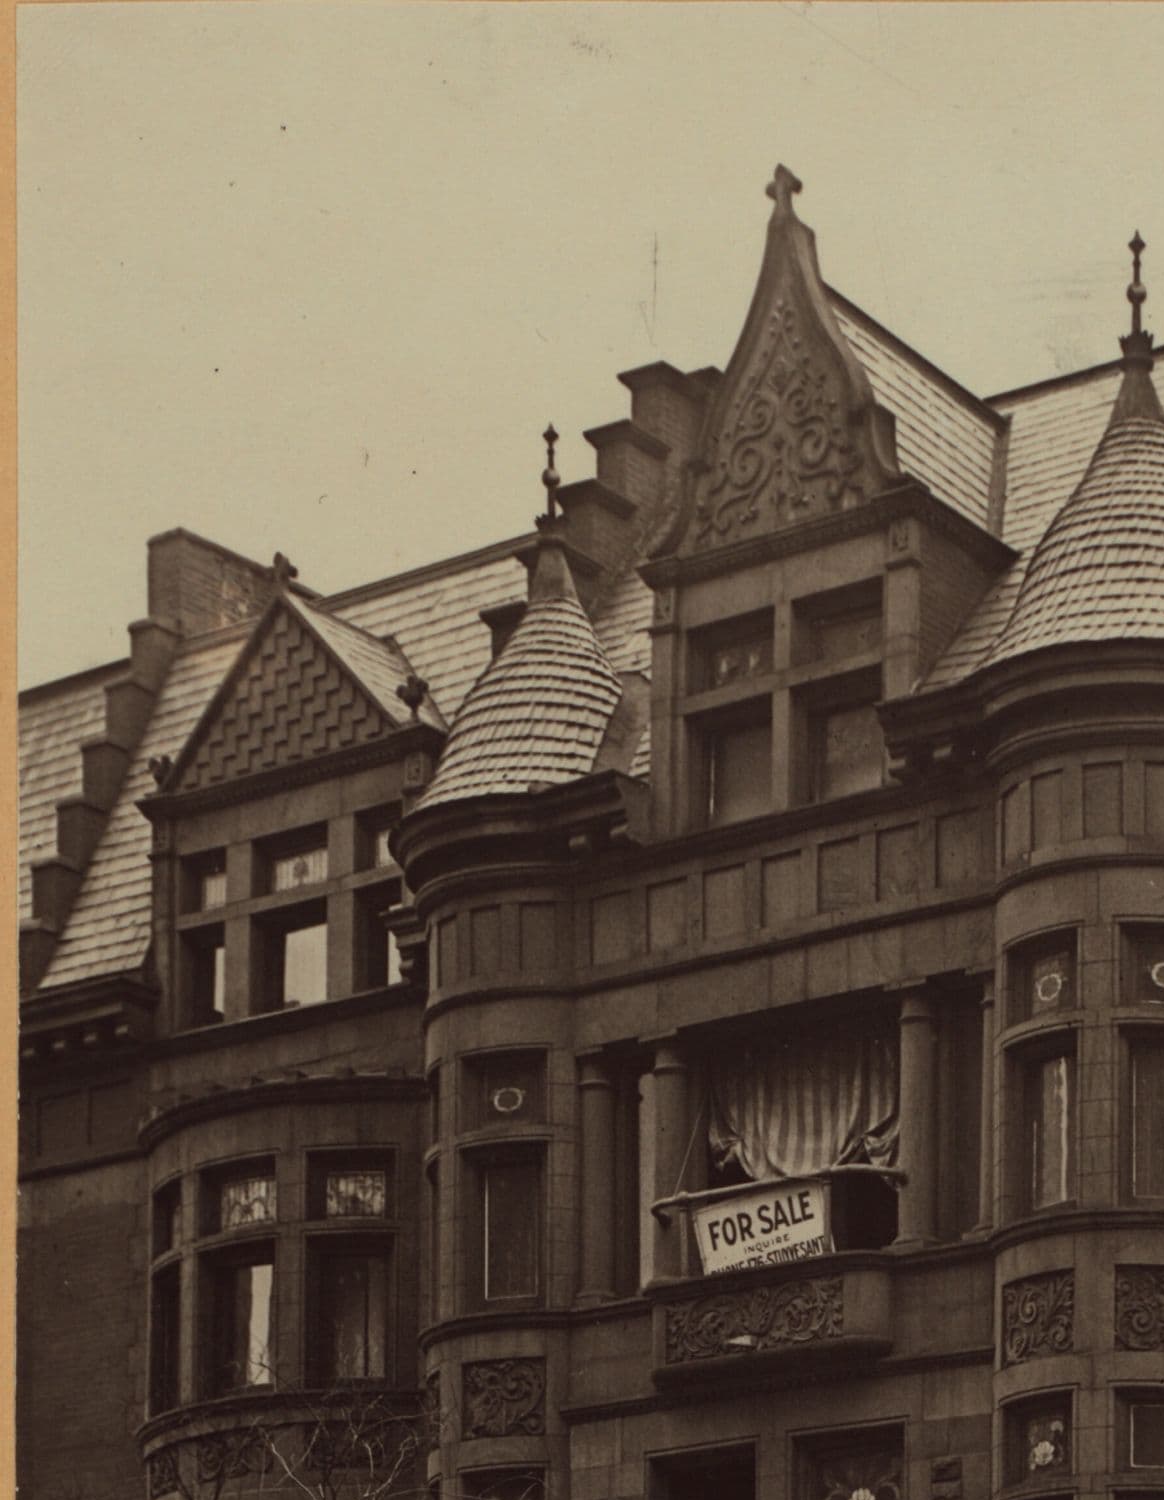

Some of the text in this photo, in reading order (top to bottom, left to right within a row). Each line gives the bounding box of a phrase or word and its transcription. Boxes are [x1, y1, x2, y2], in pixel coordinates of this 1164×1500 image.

[708, 1190, 815, 1252] FOR SALE
[743, 1233, 791, 1255] INQUIRE
